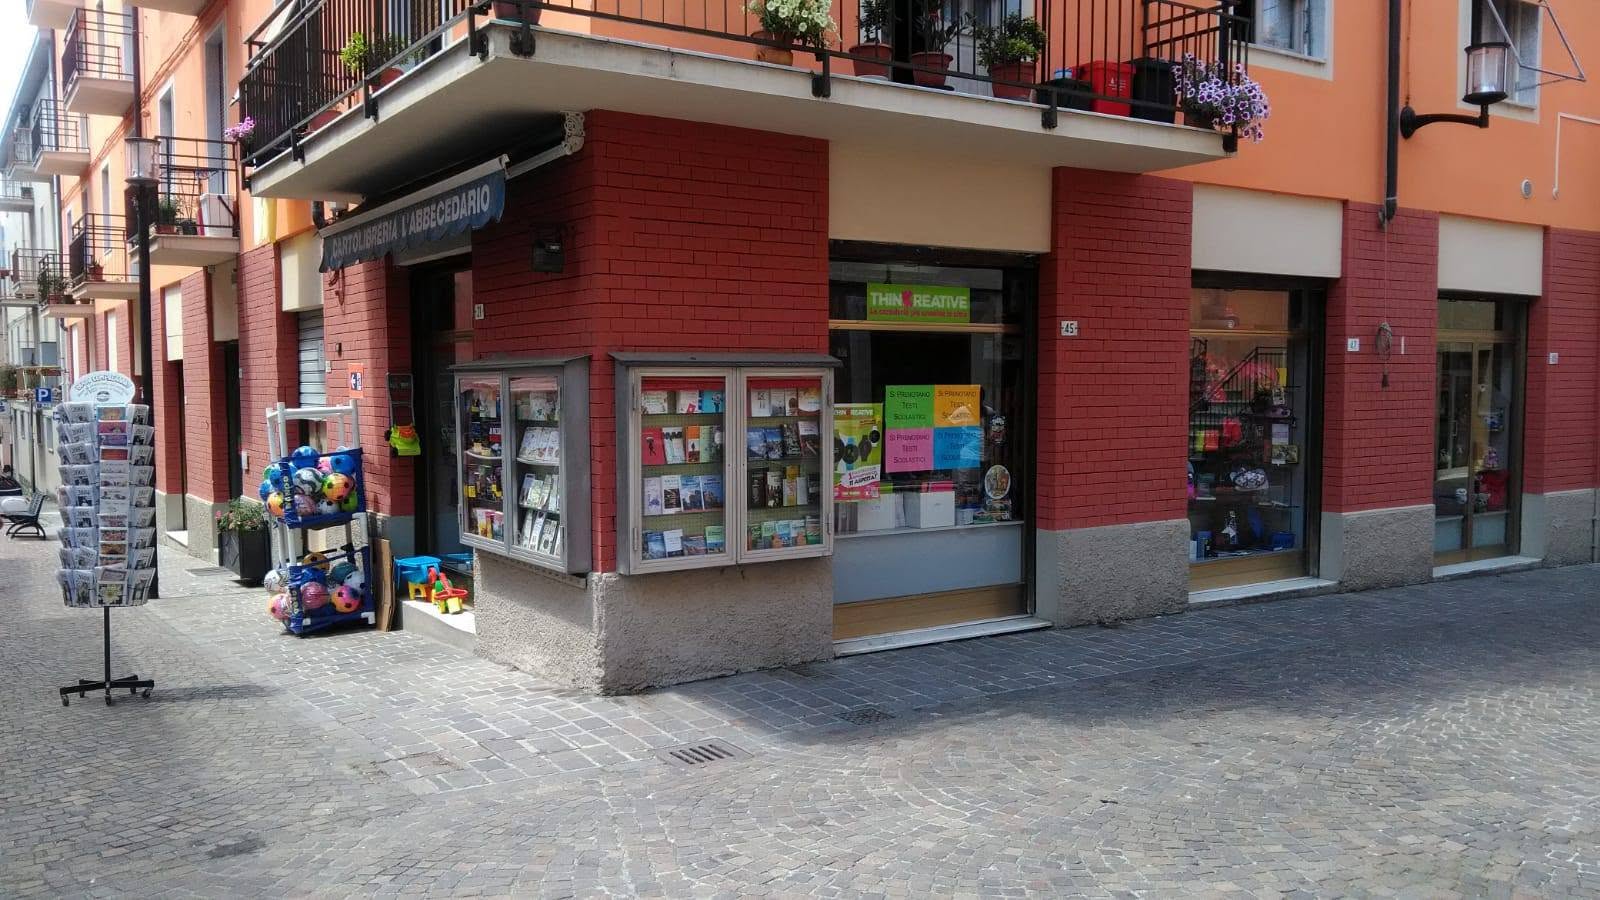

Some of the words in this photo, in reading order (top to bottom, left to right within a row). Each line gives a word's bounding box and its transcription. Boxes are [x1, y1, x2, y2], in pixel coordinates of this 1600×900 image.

[333, 214, 398, 258] CARTOLIBRERIA
[401, 184, 491, 237] L'ABBECEDARIO
[1064, 323, 1075, 334] 45
[38, 388, 49, 402] P
[896, 390, 931, 398] PRENOTANO
[893, 413, 927, 421] SCOLASTICI
[896, 433, 930, 441] PRENOTANO
[902, 444, 918, 452] TESTI
[893, 456, 926, 464] SCOLASTICI
